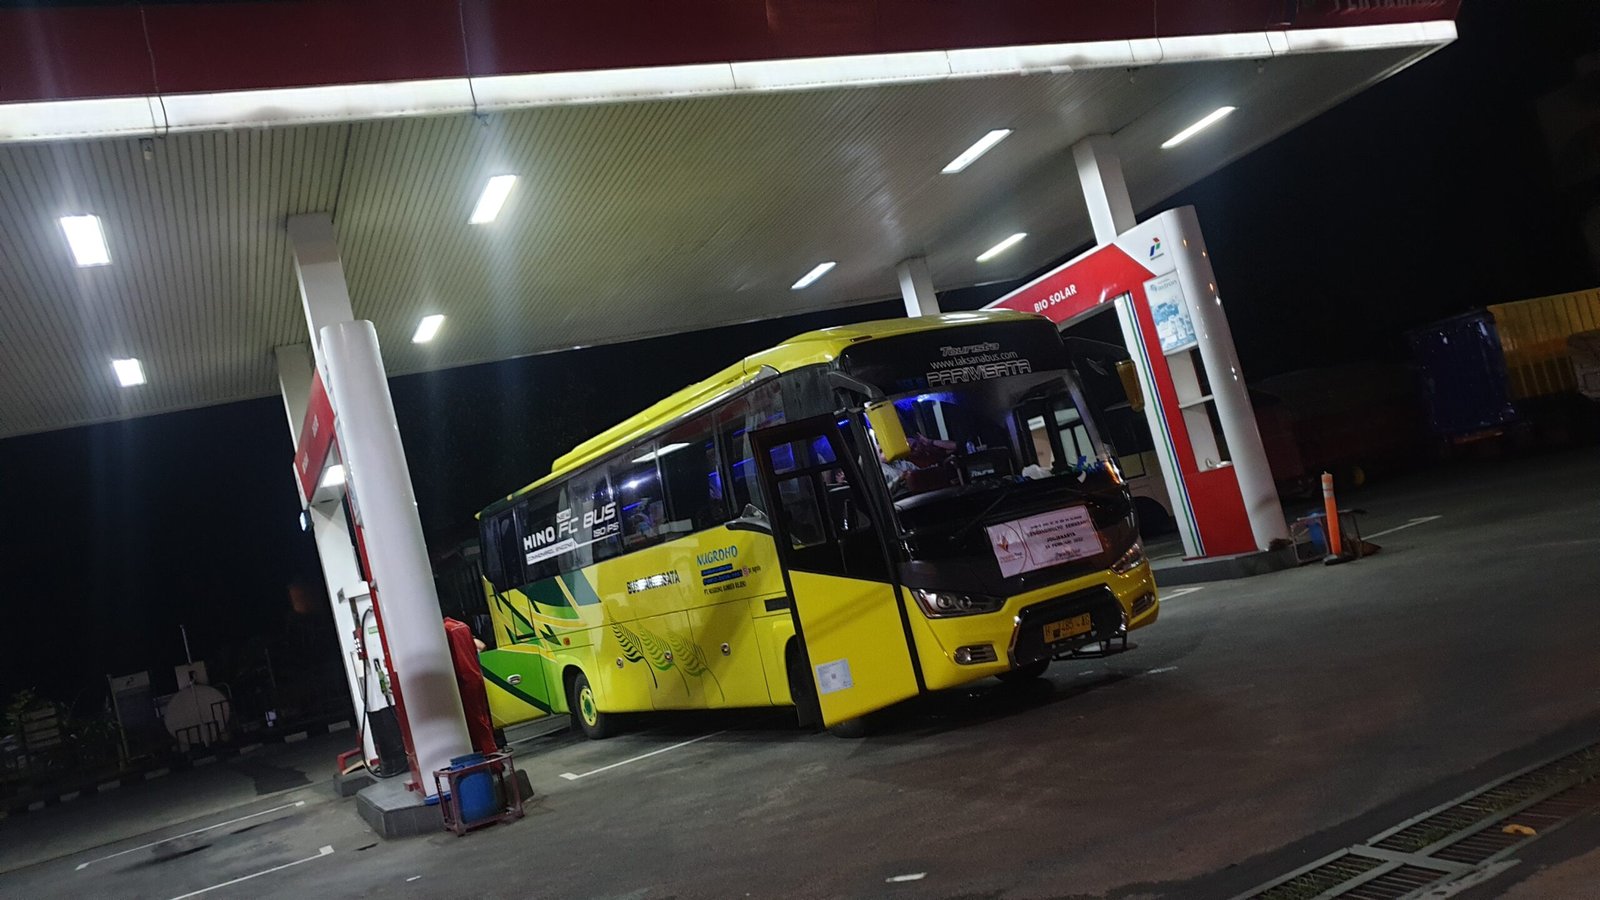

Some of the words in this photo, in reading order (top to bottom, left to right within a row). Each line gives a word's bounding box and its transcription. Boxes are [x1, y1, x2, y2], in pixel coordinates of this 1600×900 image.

[1033, 299, 1049, 313] BIO
[1049, 284, 1078, 306] SOLAR
[930, 350, 1019, 370] www.laksanabus.com
[926, 359, 1032, 387] PARIWISATA
[523, 526, 556, 551] HINO
[559, 516, 579, 539] FC
[583, 501, 617, 529] BUS
[607, 522, 620, 533] PS
[696, 545, 738, 567] NUGROHO
